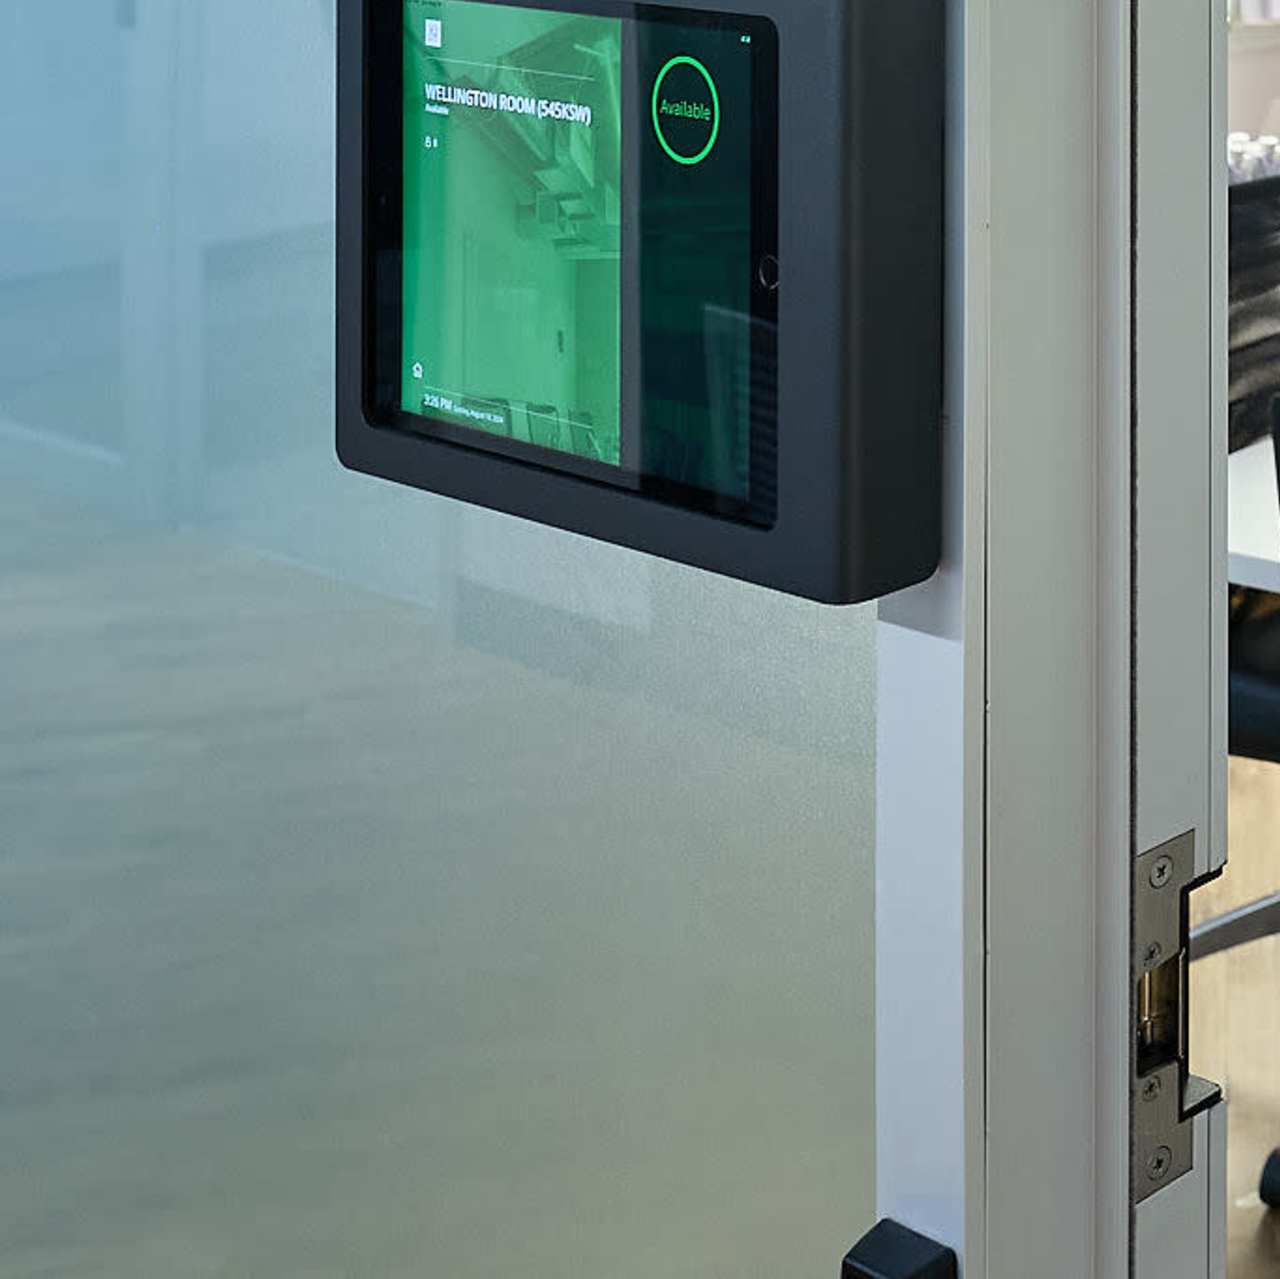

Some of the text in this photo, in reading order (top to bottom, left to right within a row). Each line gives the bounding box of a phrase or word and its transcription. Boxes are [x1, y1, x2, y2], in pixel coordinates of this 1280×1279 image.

[425, 83, 592, 126] WELLINGTON ROOM (545KSW)
[660, 99, 711, 121] Available
